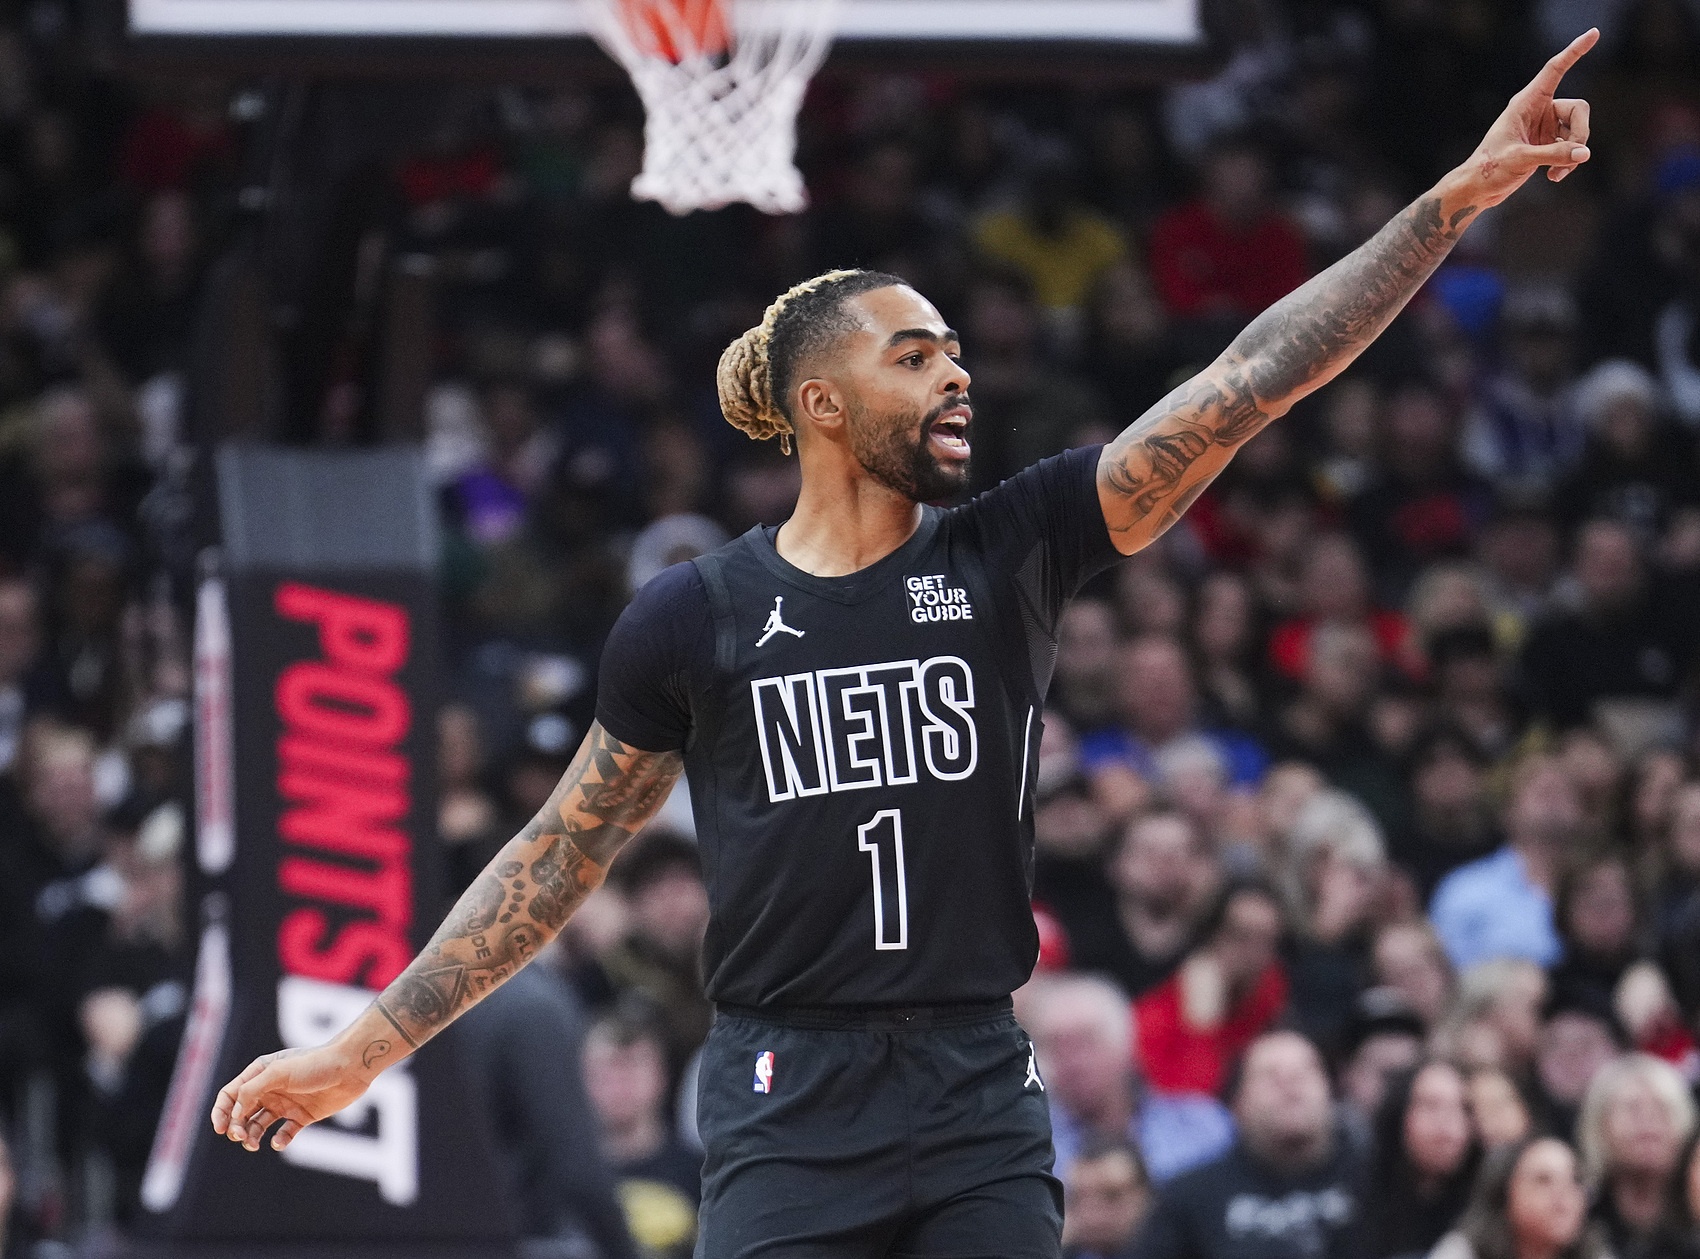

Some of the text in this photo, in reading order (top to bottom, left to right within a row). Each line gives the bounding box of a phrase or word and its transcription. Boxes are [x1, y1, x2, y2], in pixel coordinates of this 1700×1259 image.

[906, 574, 945, 592] GET
[908, 588, 968, 607] YOUR
[911, 604, 973, 623] GUIDE
[750, 655, 978, 803] NETS
[857, 808, 908, 951] 1
